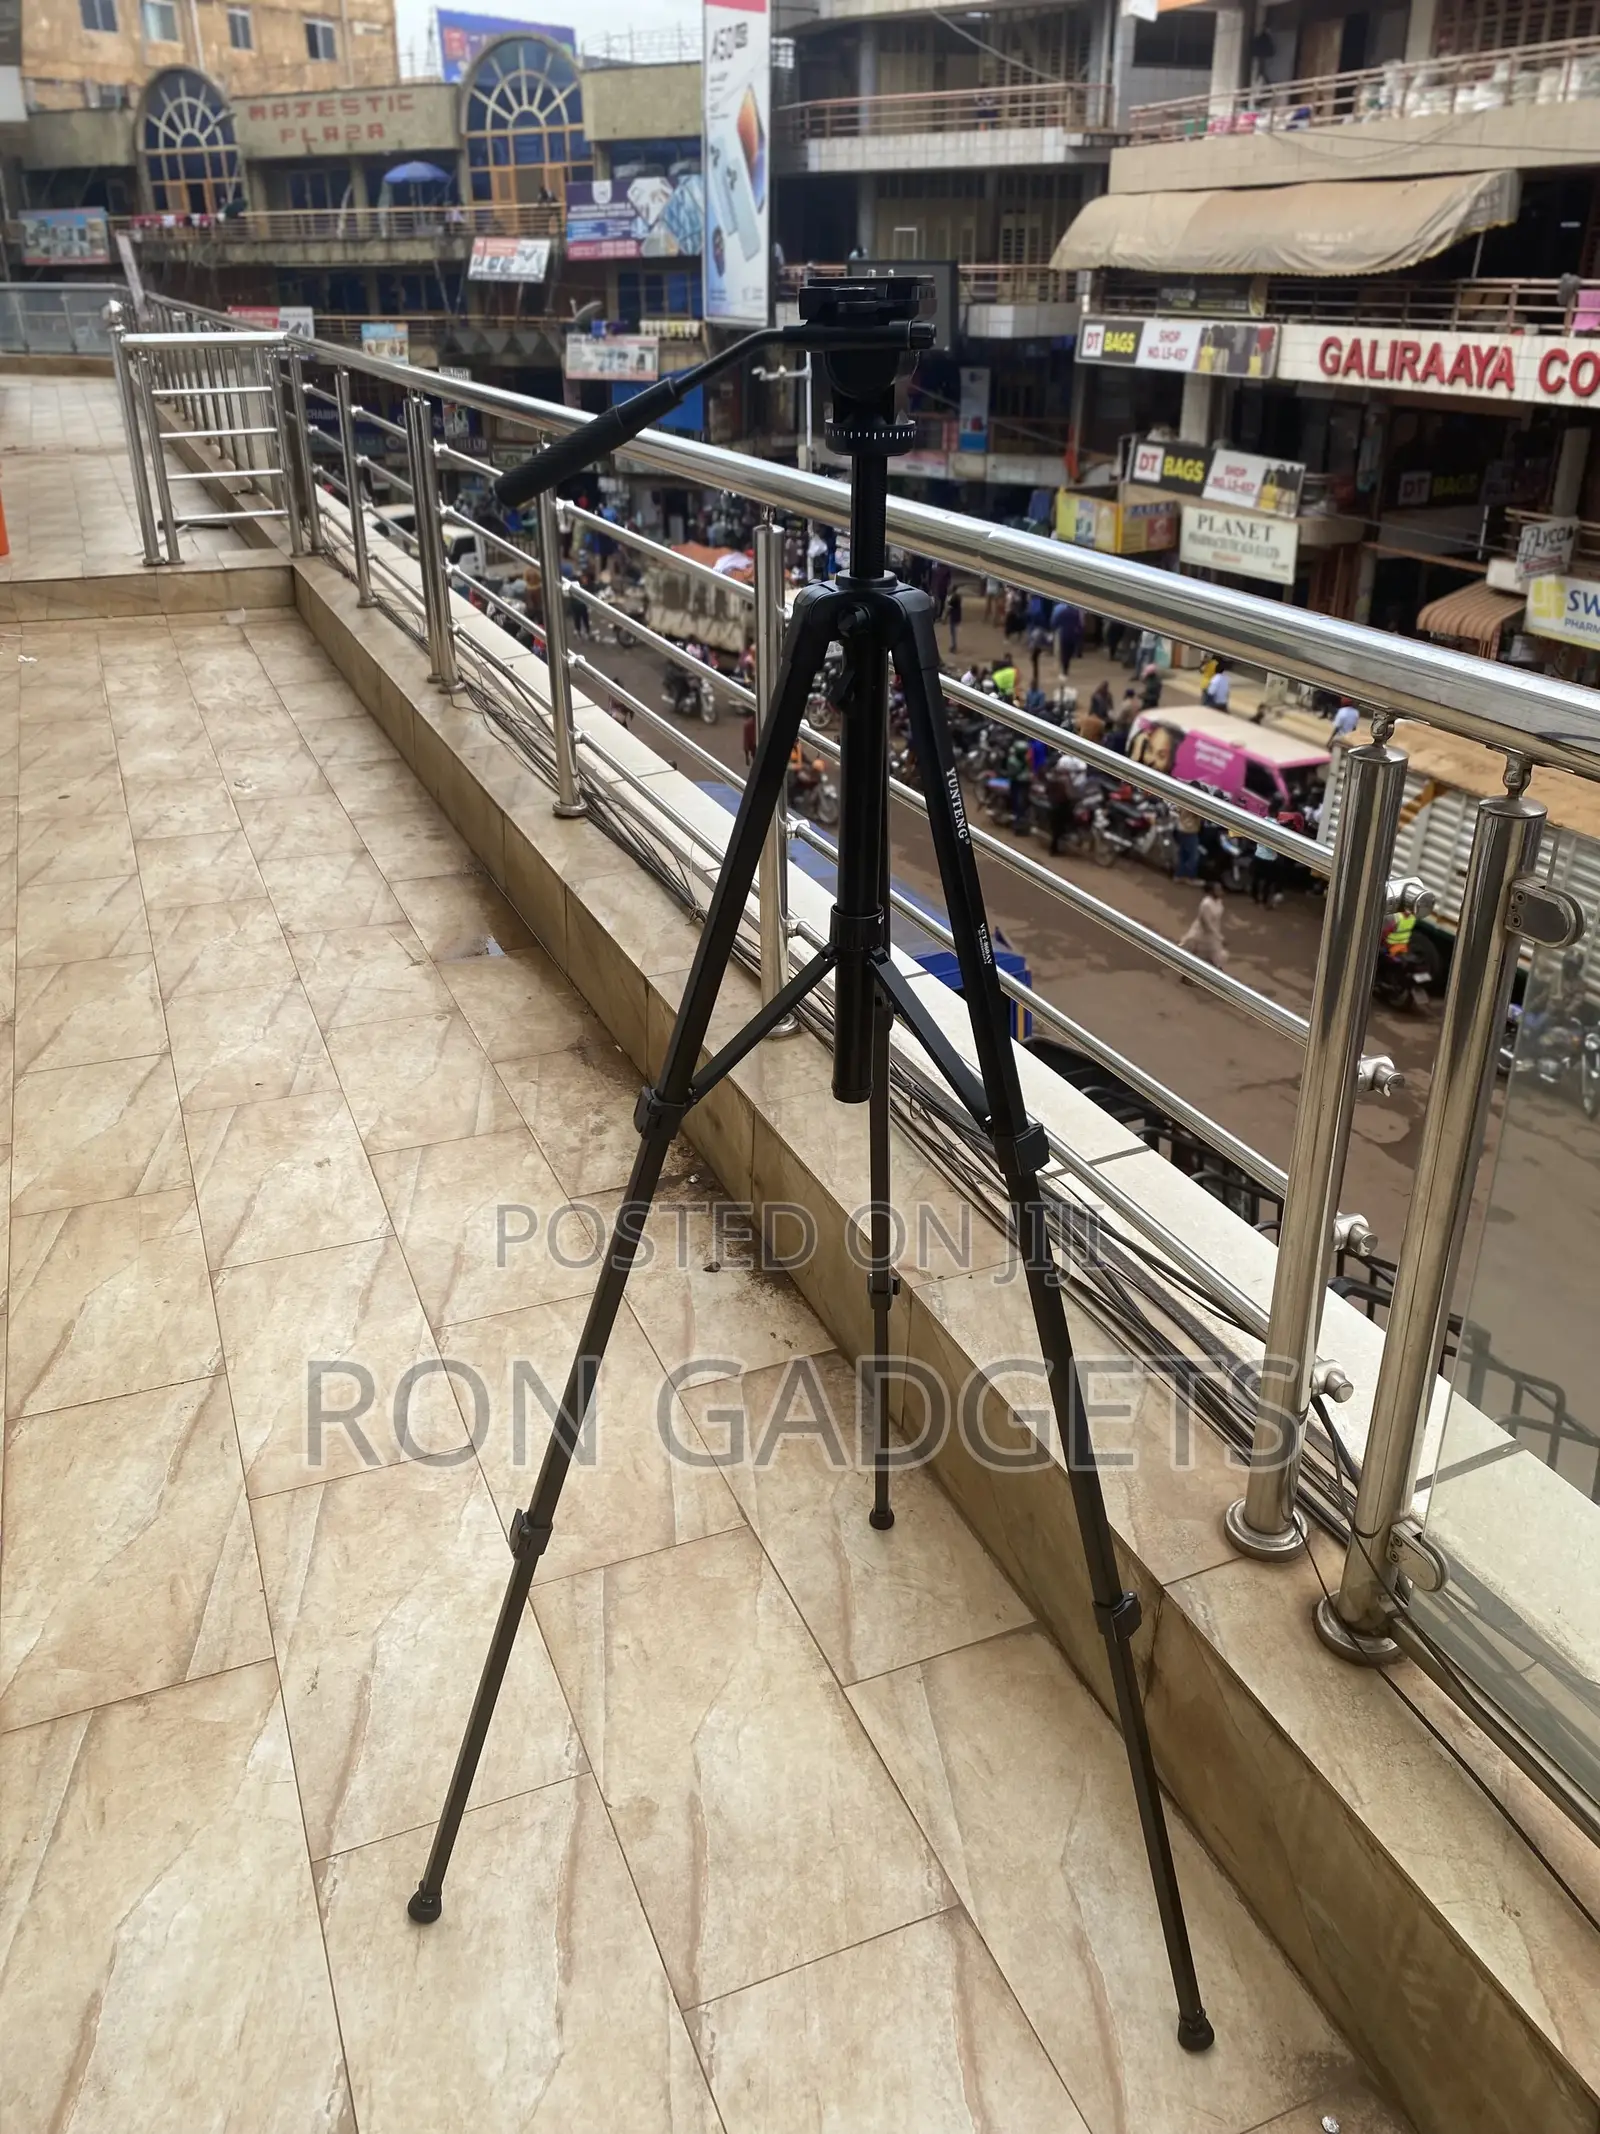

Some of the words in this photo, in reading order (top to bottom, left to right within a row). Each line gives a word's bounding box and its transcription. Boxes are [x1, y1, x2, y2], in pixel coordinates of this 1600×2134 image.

[248, 93, 415, 121] MAJESTIC
[280, 122, 385, 144] PLAZA
[1085, 332, 1101, 350] DT
[1103, 331, 1136, 354] BAGS
[1158, 330, 1181, 344] SHOP
[1319, 336, 1515, 392] GALIRAAYA
[1138, 452, 1159, 473] DT
[1163, 456, 1205, 482] BAGS
[1224, 464, 1247, 477] SHOP
[1198, 513, 1275, 542] PLANET
[946, 767, 968, 840] YUNTENG
